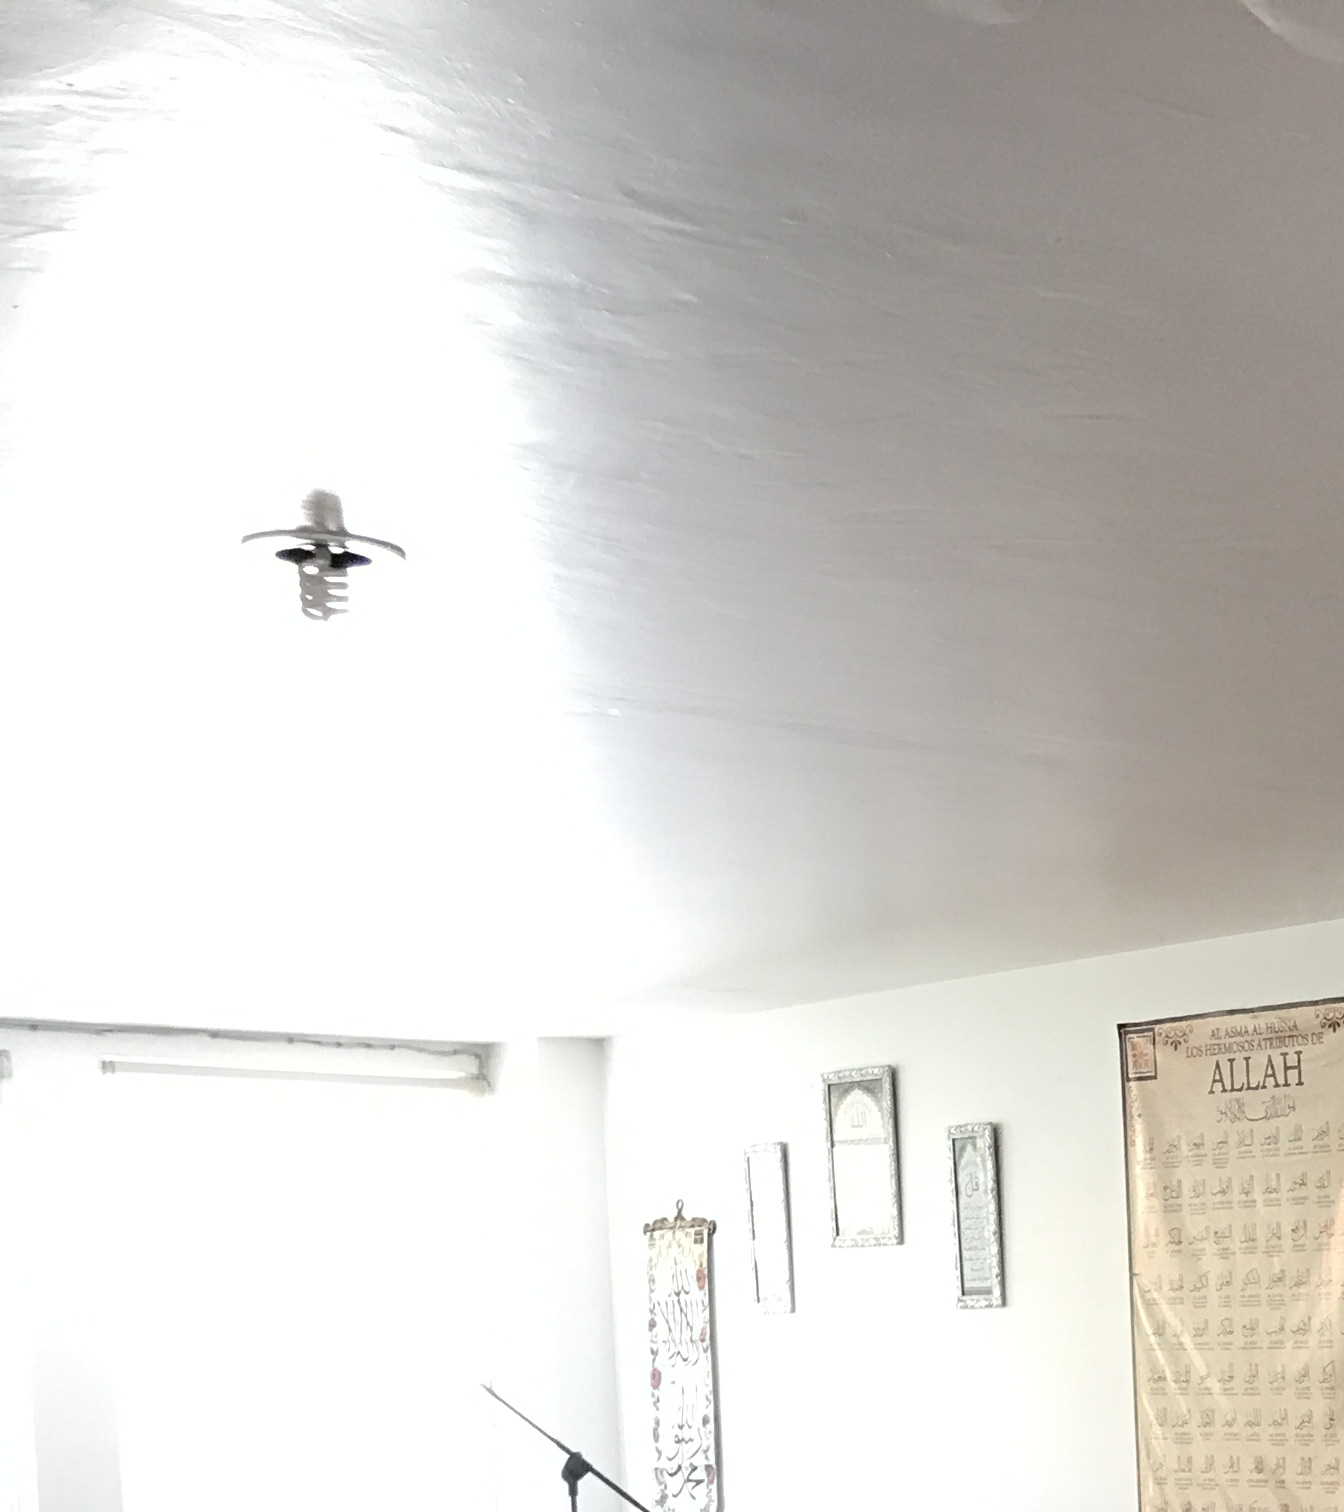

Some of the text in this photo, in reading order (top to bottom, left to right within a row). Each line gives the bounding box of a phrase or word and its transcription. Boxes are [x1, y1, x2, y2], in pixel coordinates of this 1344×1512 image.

[1185, 1031, 1325, 1059] LOS HERMOSOS ATRIBUTOS DE
[1210, 1027, 1223, 1041] AL
[1224, 1026, 1249, 1039] ASMA
[1251, 1022, 1264, 1036] AL
[1208, 1050, 1305, 1095] ALLAH
